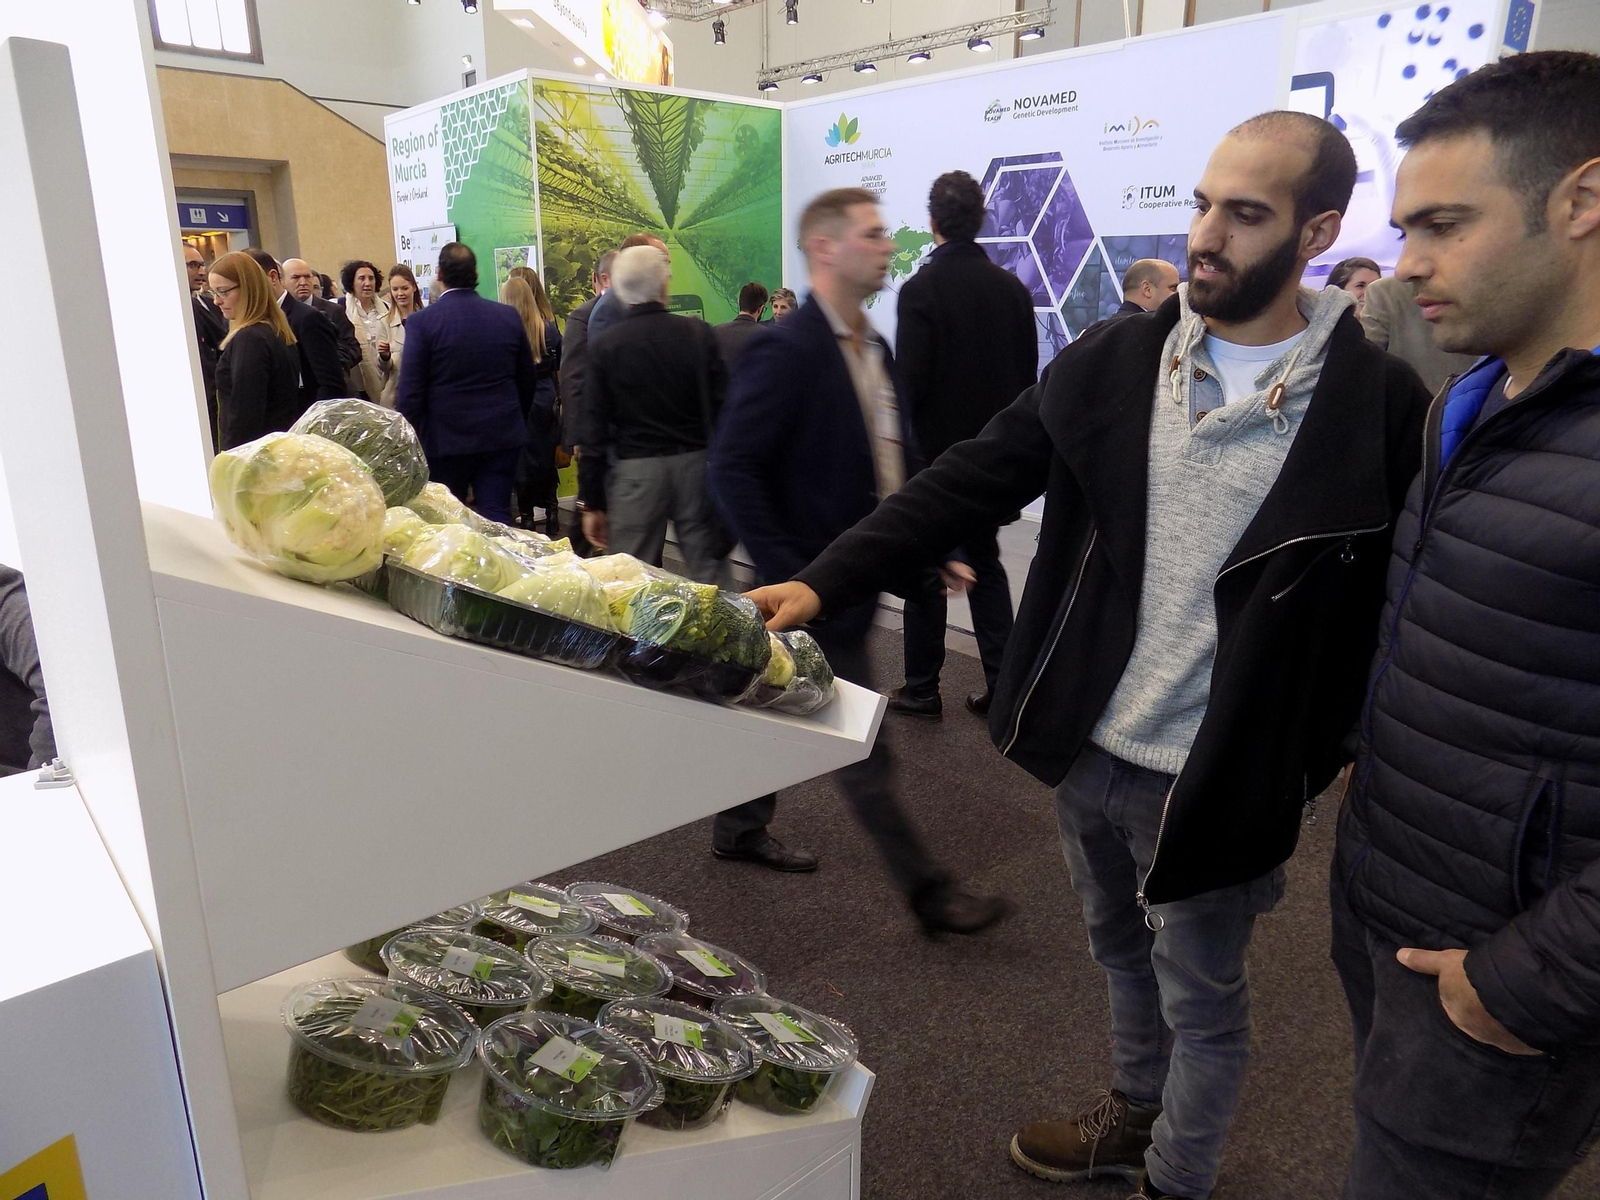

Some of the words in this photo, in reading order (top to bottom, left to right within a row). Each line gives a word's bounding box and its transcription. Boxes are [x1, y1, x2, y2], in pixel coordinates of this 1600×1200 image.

[1013, 90, 1077, 111] NOVAMED
[1012, 109, 1036, 120] Genetic
[1036, 104, 1079, 117] Development
[392, 131, 426, 159] Region
[428, 123, 439, 149] of
[824, 147, 893, 165] AGRITECHMURCIA
[394, 157, 427, 184] Murcia
[1140, 184, 1175, 199] ITUM
[1138, 200, 1183, 209] Cooperative
